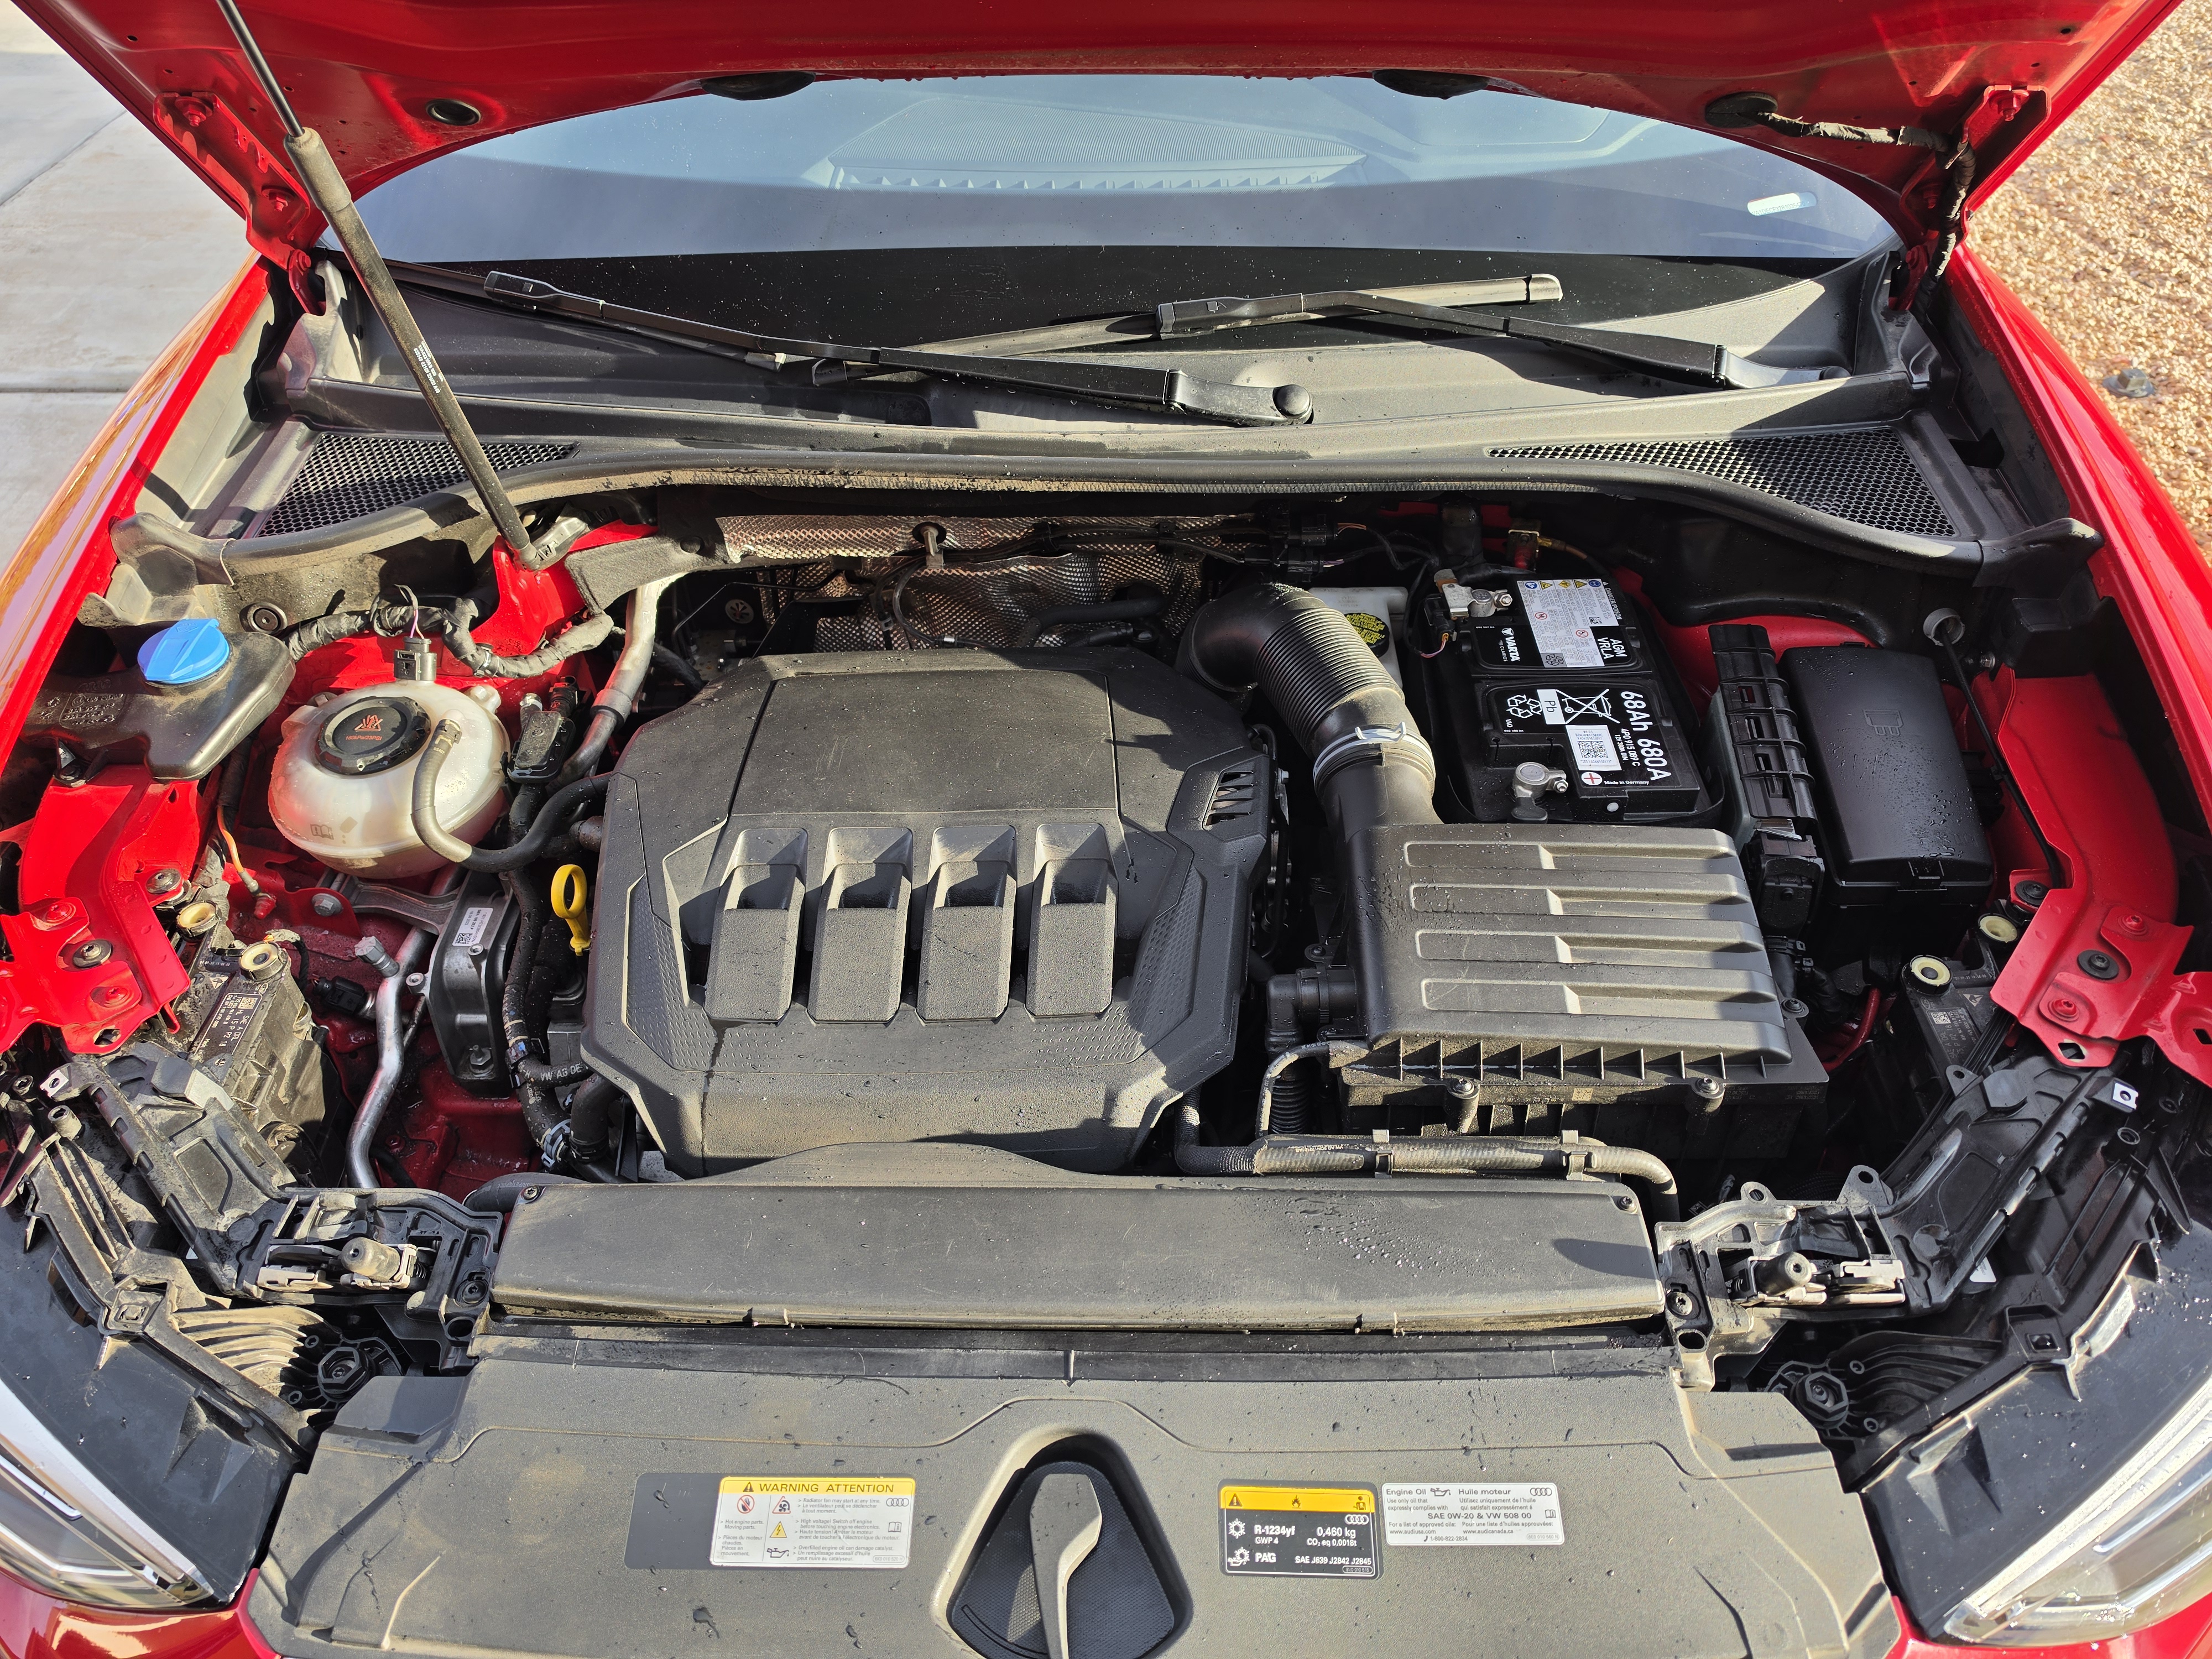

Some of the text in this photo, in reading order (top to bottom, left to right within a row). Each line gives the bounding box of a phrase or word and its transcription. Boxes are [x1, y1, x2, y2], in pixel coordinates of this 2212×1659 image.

[1605, 588, 1623, 619] DANGER/POISON
[1505, 636, 1520, 661] VARTA
[1597, 637, 1614, 659] VRLA
[1610, 639, 1627, 657] AGM
[1544, 700, 1557, 713] Pb
[1621, 691, 1672, 781] 68Ah 680A
[1624, 740, 1635, 750] 915
[1629, 750, 1639, 761] 089
[541, 1072, 552, 1081] VW
[556, 1067, 568, 1079] AG
[758, 1483, 894, 1492] WARNING ATTENTION
[1253, 1524, 1296, 1537] R-1234yf
[1316, 1526, 1356, 1538] 0,460 kg
[1254, 1536, 1272, 1545] GWP
[1332, 1538, 1357, 1547] 0,0018t
[1254, 1552, 1276, 1563] PAG
[1295, 1555, 1310, 1563] SAE
[1329, 1557, 1349, 1565] J2842
[1350, 1557, 1371, 1566] J2845
